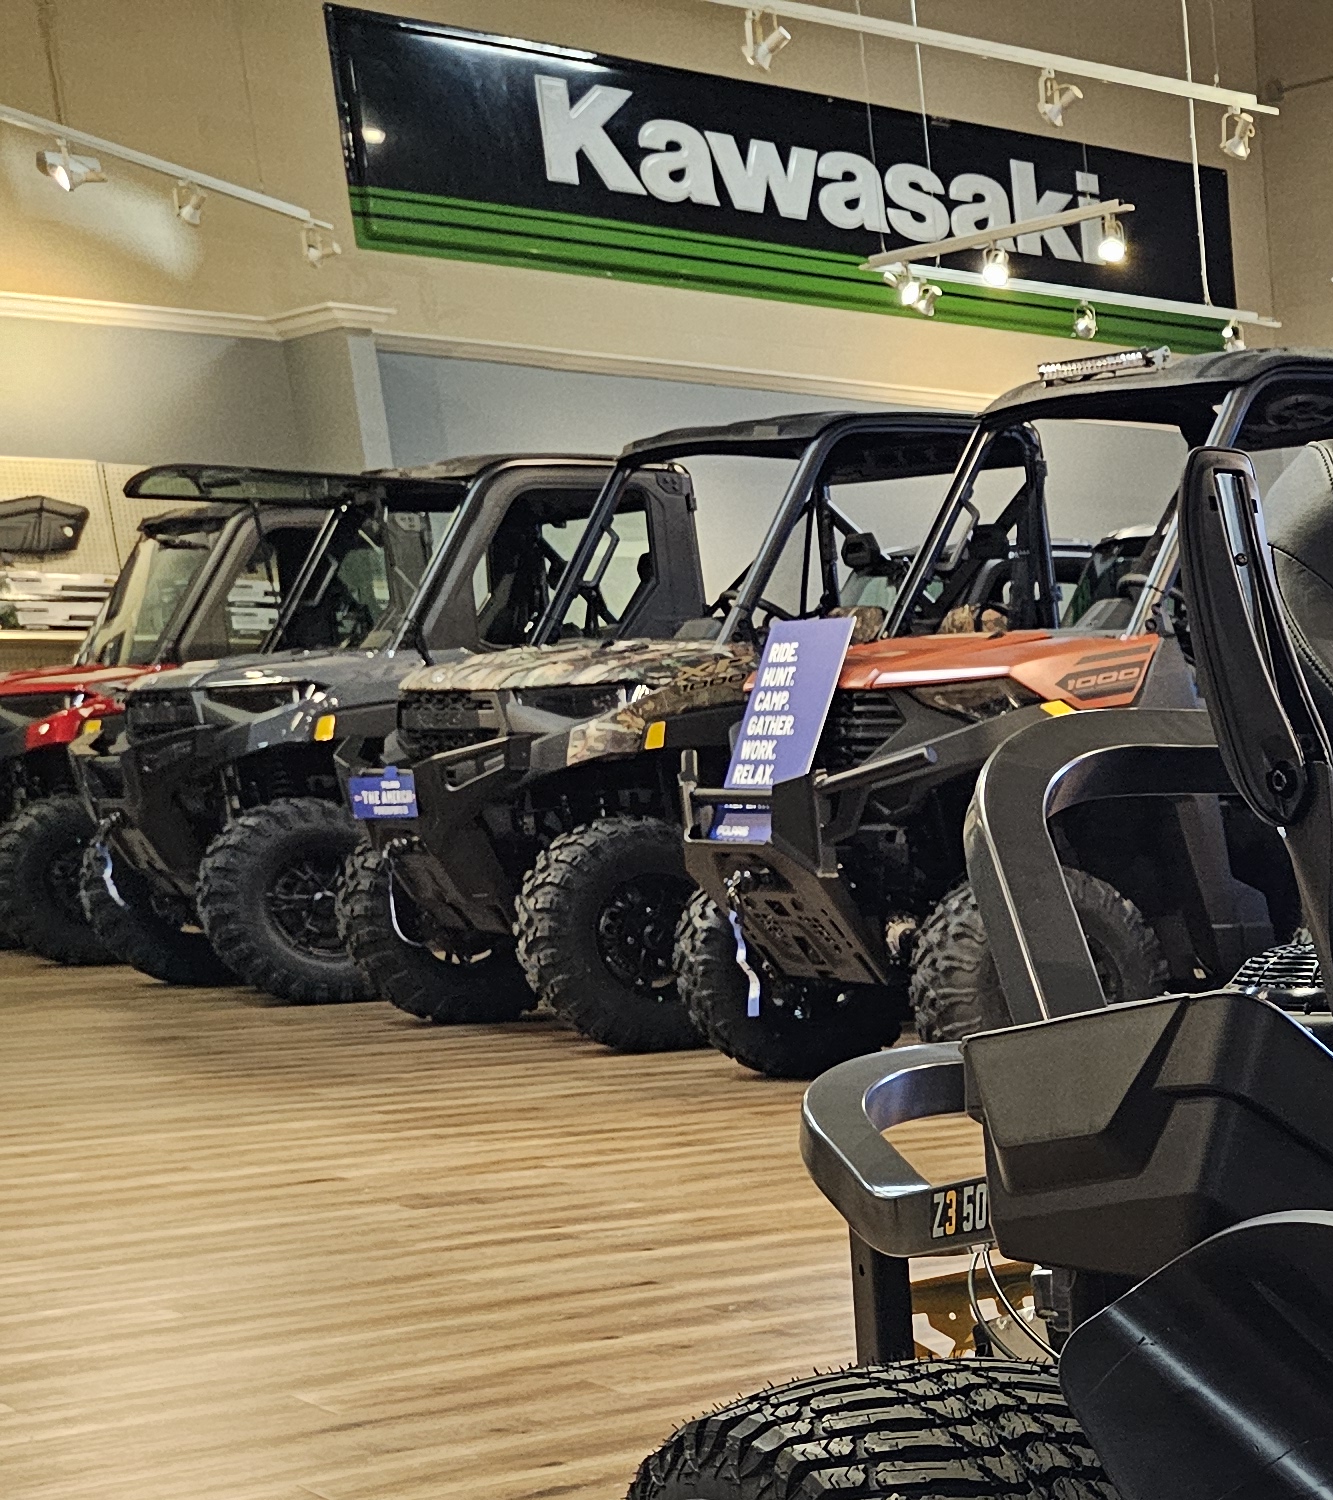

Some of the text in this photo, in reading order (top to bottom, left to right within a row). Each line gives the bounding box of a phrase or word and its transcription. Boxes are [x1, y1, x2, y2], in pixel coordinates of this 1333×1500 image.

[533, 73, 1102, 265] Kawasaki
[768, 641, 799, 663] RIDE.
[682, 672, 746, 692] 1000
[760, 666, 797, 687] HUNT.
[1067, 667, 1140, 691] 1000
[753, 690, 790, 711] CAMP.
[746, 715, 795, 736] GATHER.
[740, 740, 777, 761] WORK.
[731, 764, 774, 785] RELAX.
[932, 1189, 957, 1238] Z3
